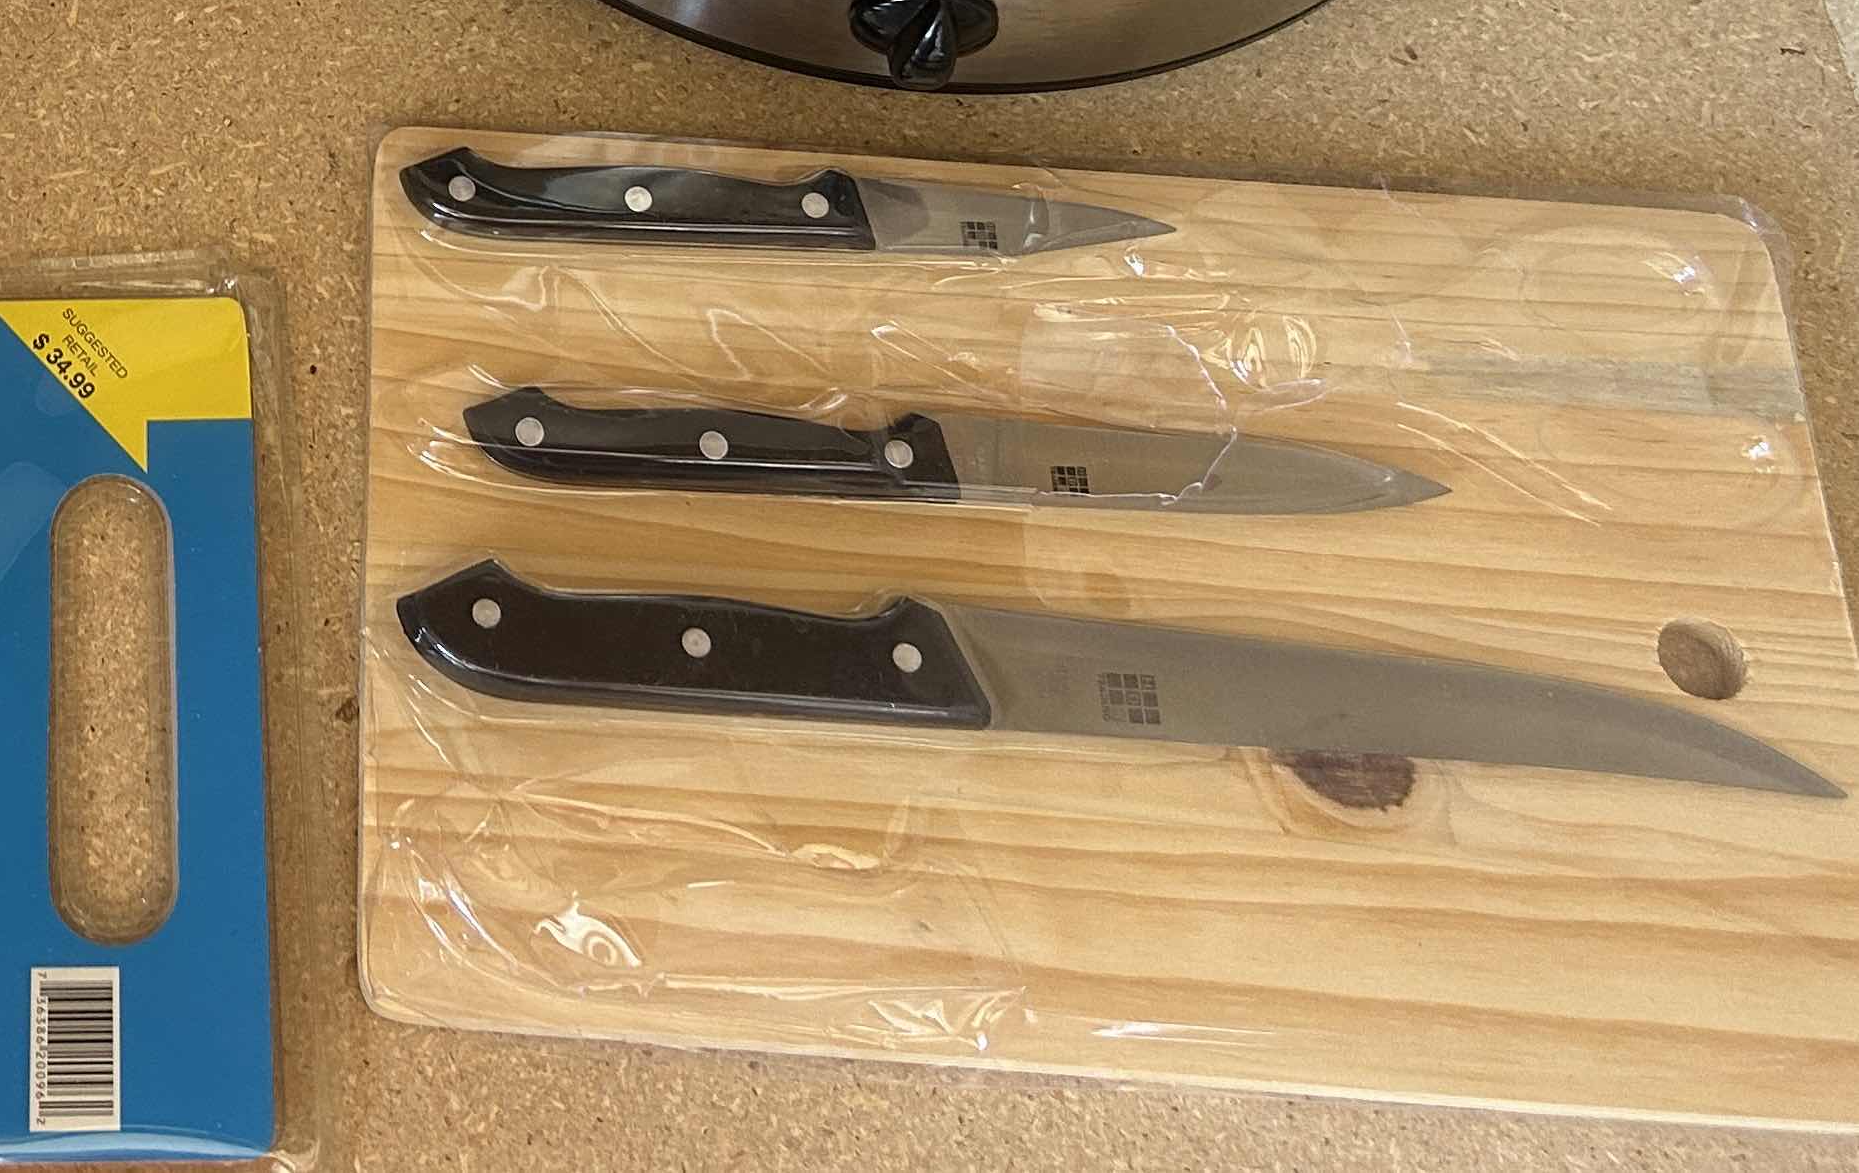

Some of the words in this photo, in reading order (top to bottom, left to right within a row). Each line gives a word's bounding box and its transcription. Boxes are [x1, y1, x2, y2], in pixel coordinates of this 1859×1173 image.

[61, 307, 129, 380] SUGGESTED
[61, 334, 99, 377] RETAIL
[45, 347, 96, 399] 34.99
